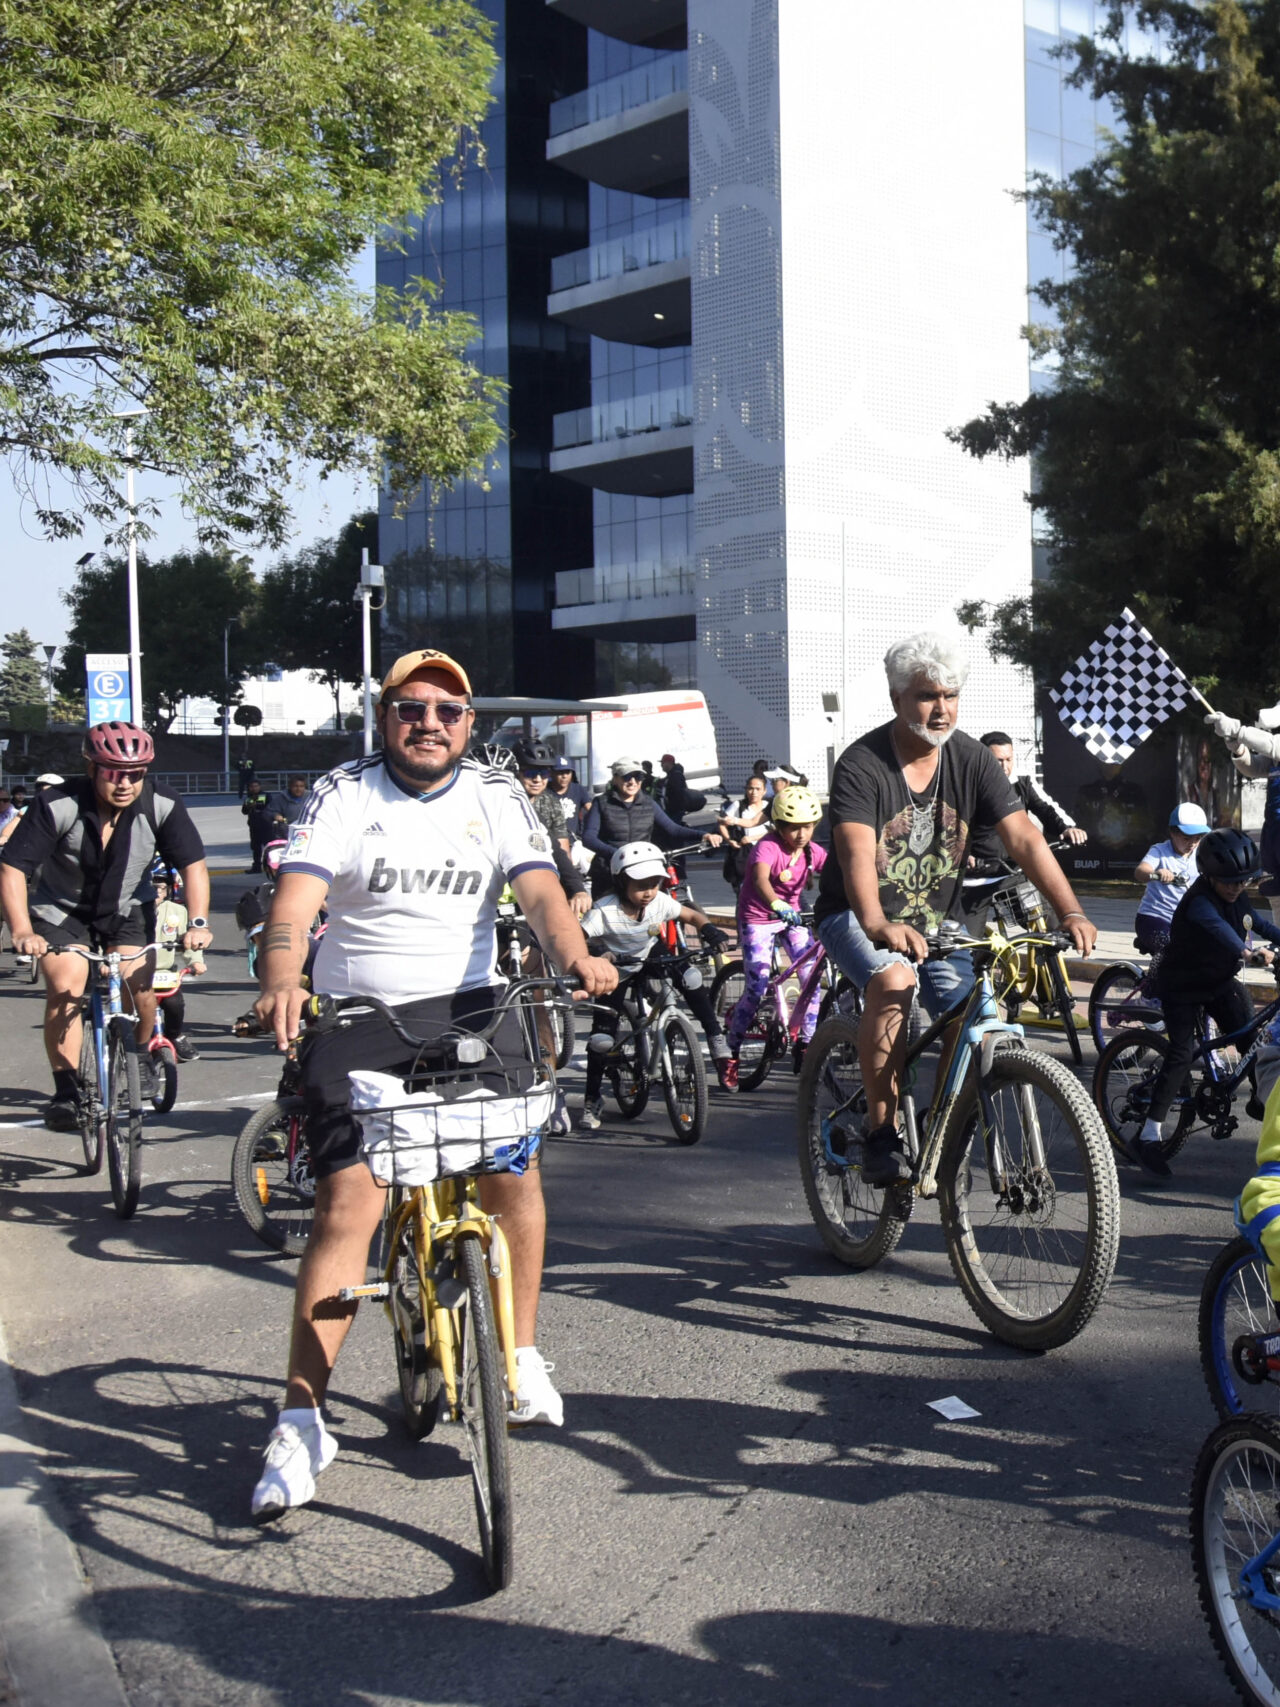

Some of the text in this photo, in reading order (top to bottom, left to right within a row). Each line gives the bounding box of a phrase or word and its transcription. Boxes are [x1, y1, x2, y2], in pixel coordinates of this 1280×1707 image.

[102, 676, 116, 692] E
[95, 700, 125, 719] 37
[1074, 859, 1100, 869] BUAP
[367, 857, 483, 895] bwin
